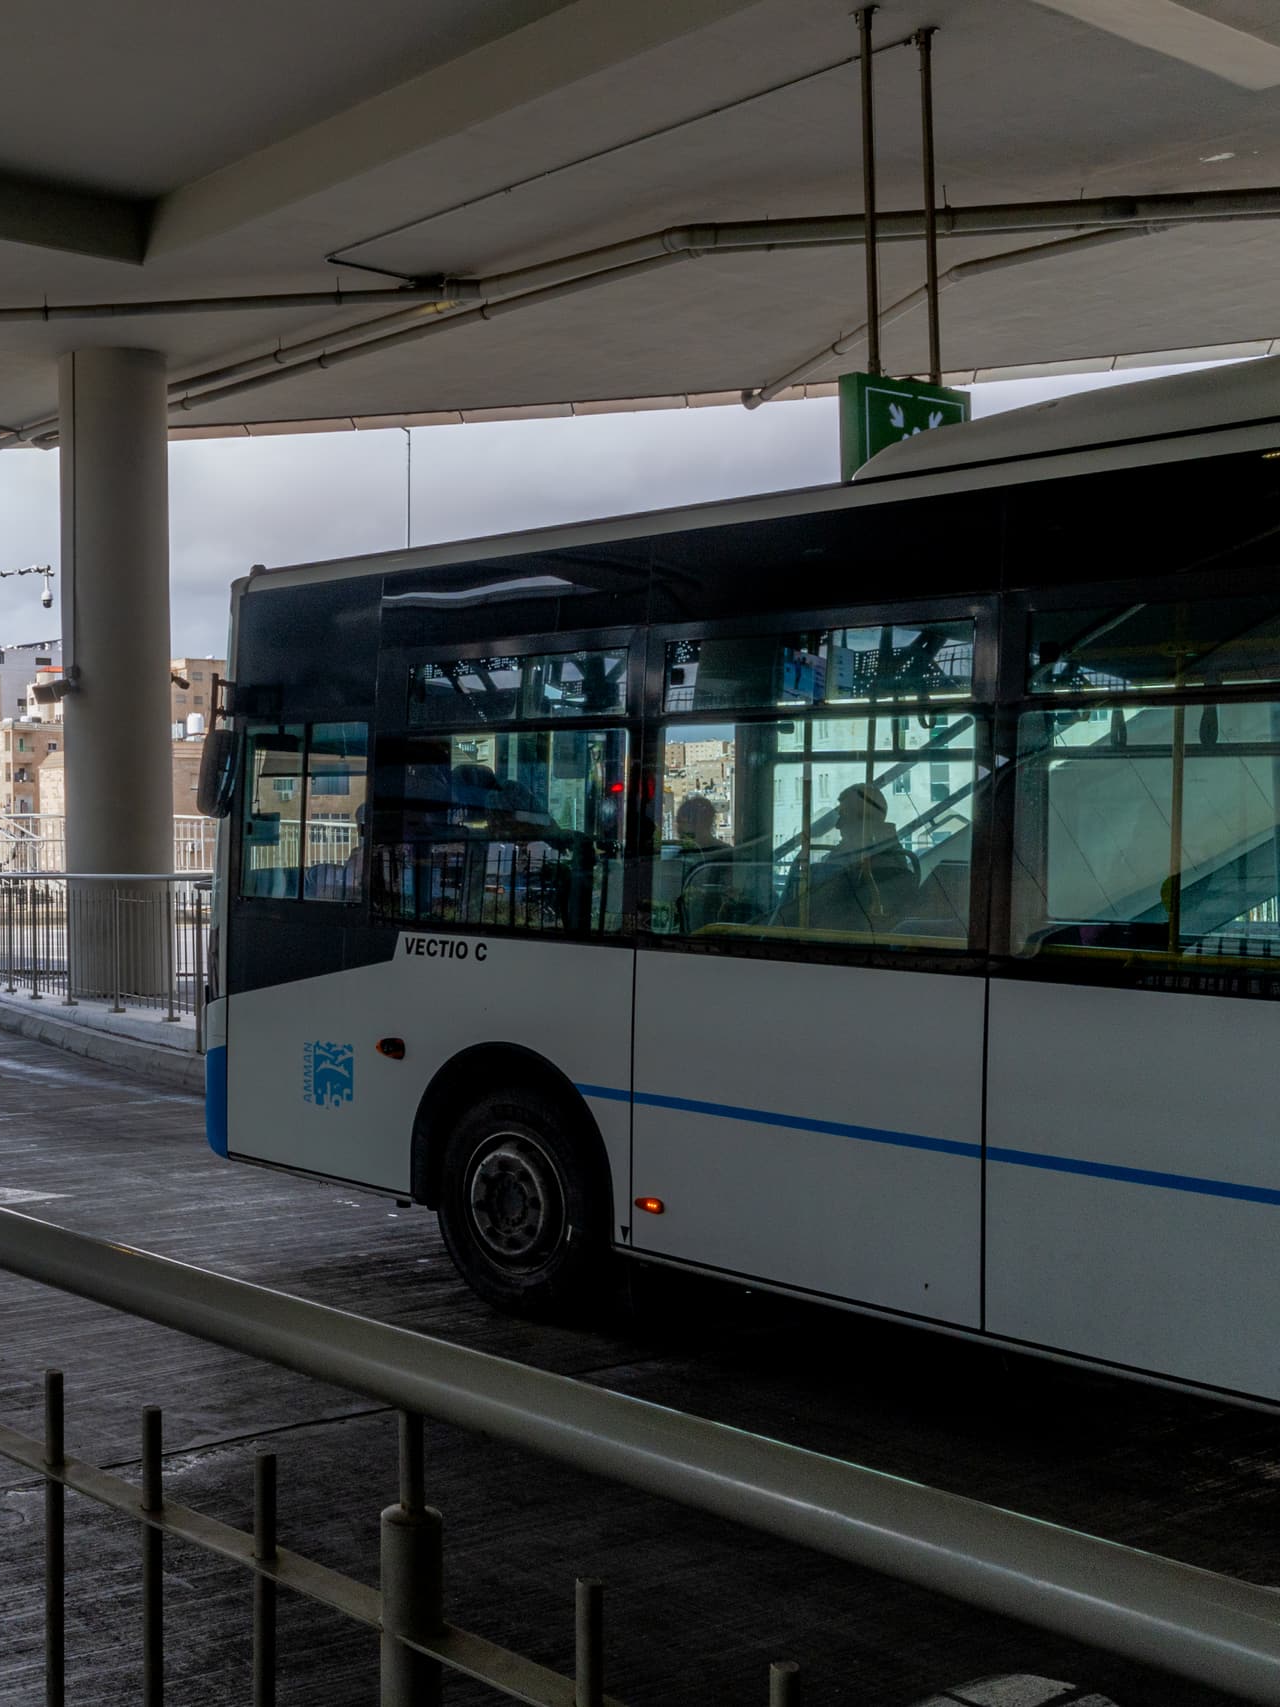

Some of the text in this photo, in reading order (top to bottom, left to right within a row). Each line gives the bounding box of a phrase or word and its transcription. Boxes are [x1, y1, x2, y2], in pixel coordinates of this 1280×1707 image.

[405, 937, 488, 961] VECTIO C
[303, 1042, 313, 1104] AMMAN
